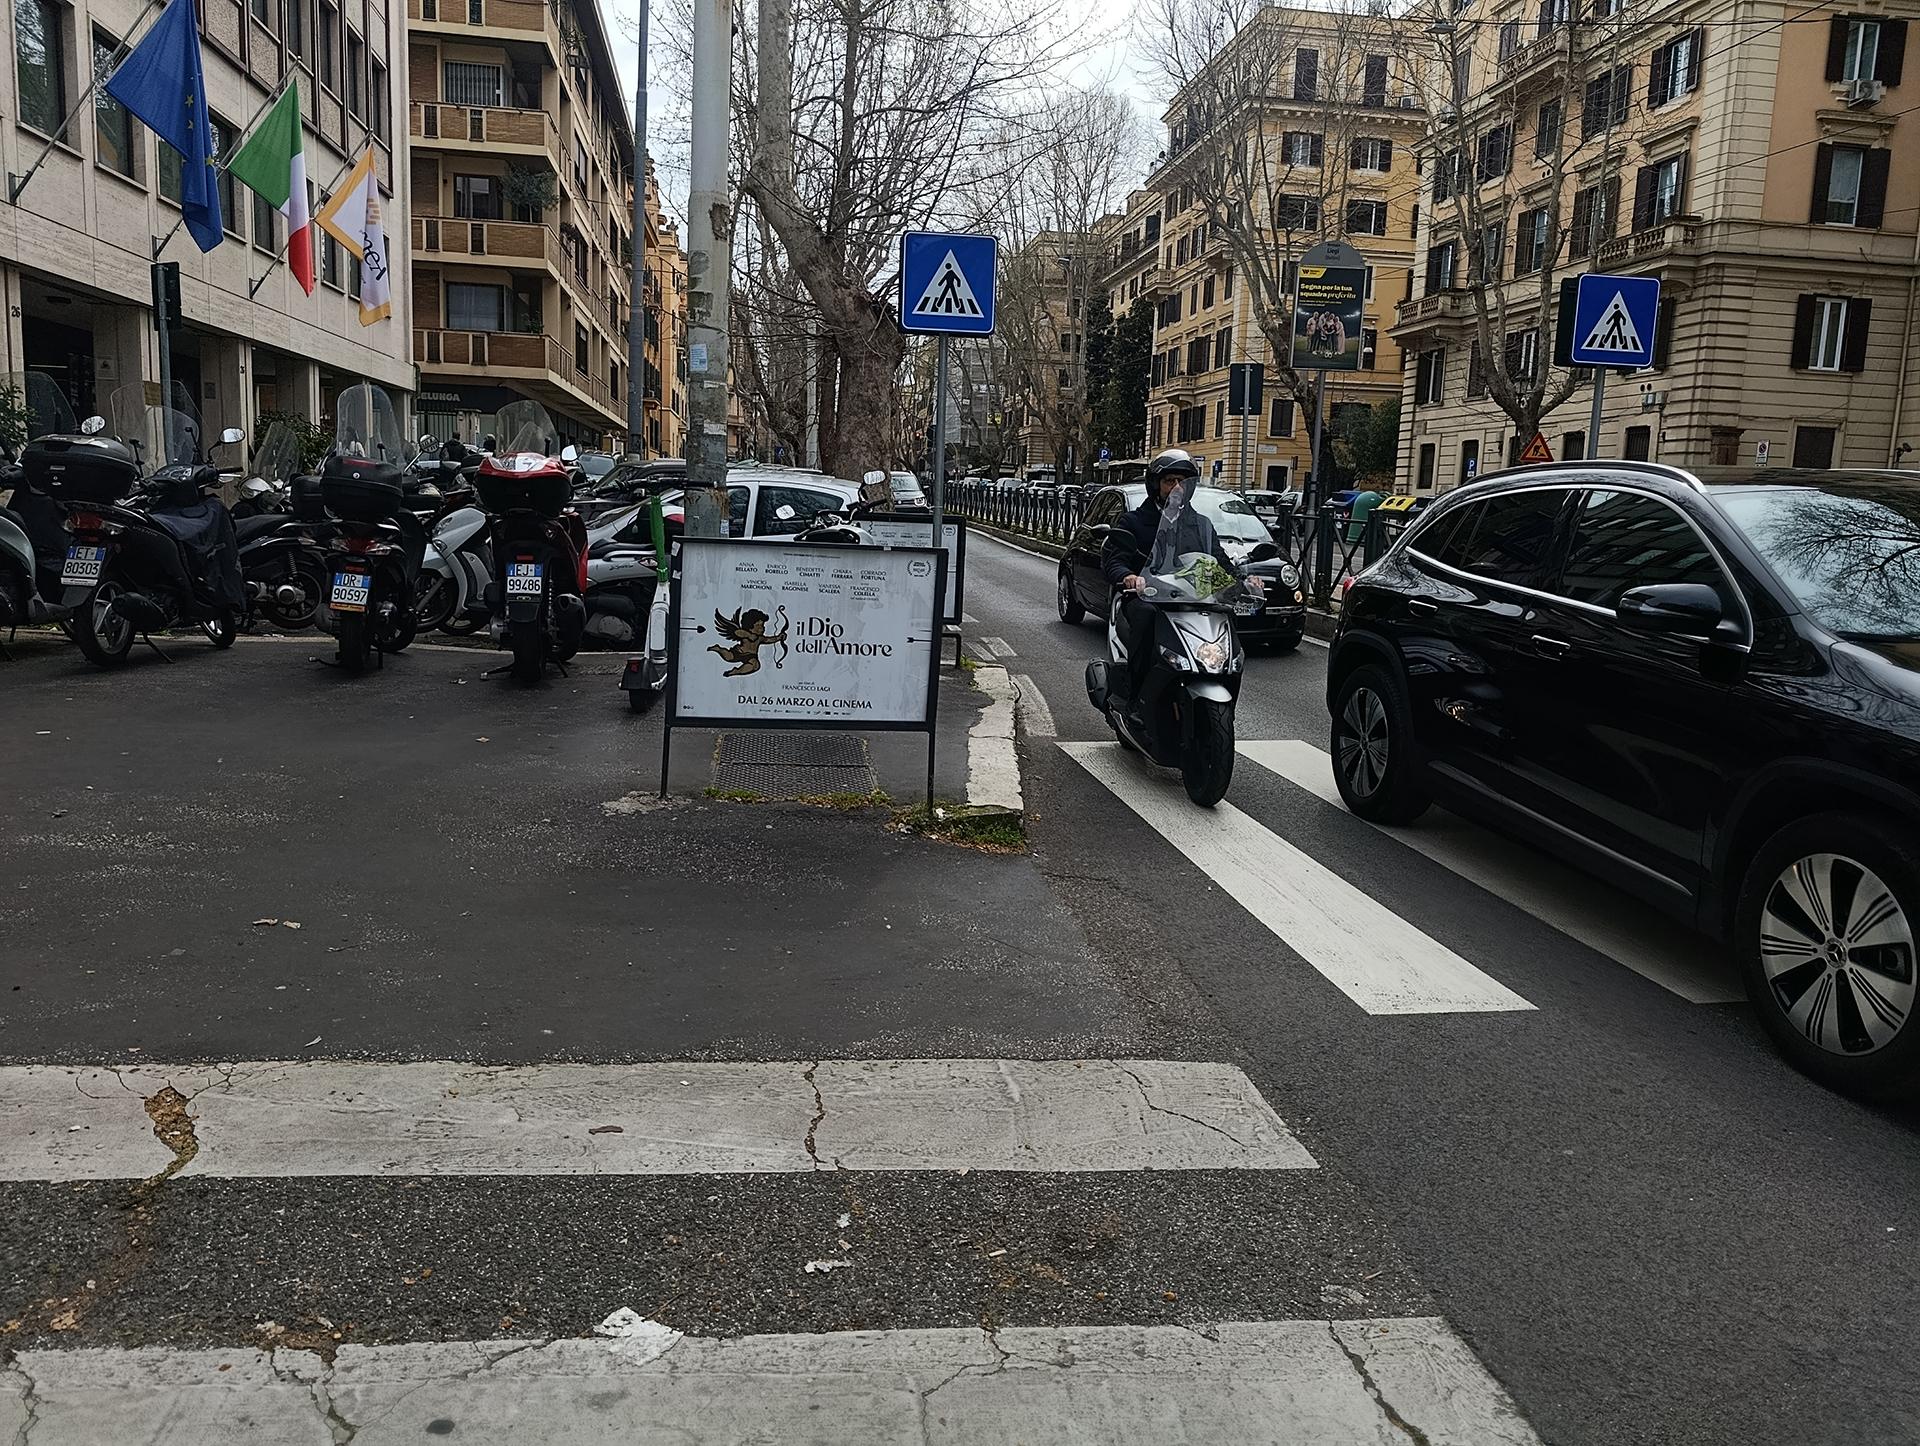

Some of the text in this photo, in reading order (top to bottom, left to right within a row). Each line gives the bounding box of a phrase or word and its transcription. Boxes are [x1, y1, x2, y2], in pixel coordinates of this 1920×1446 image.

[1300, 283, 1321, 291] Segna
[1101, 449, 1108, 458] P
[1469, 460, 1474, 470] P
[76, 547, 91, 559] ET
[65, 562, 99, 575] 80303
[516, 565, 529, 576] EJ
[343, 575, 357, 586] DR
[508, 579, 541, 591] 99486
[333, 588, 367, 602] 90597
[796, 617, 844, 637] il Dio
[795, 637, 892, 657] dell'Amore
[737, 695, 872, 709] DAL 26 MARZO AL CINEMA
